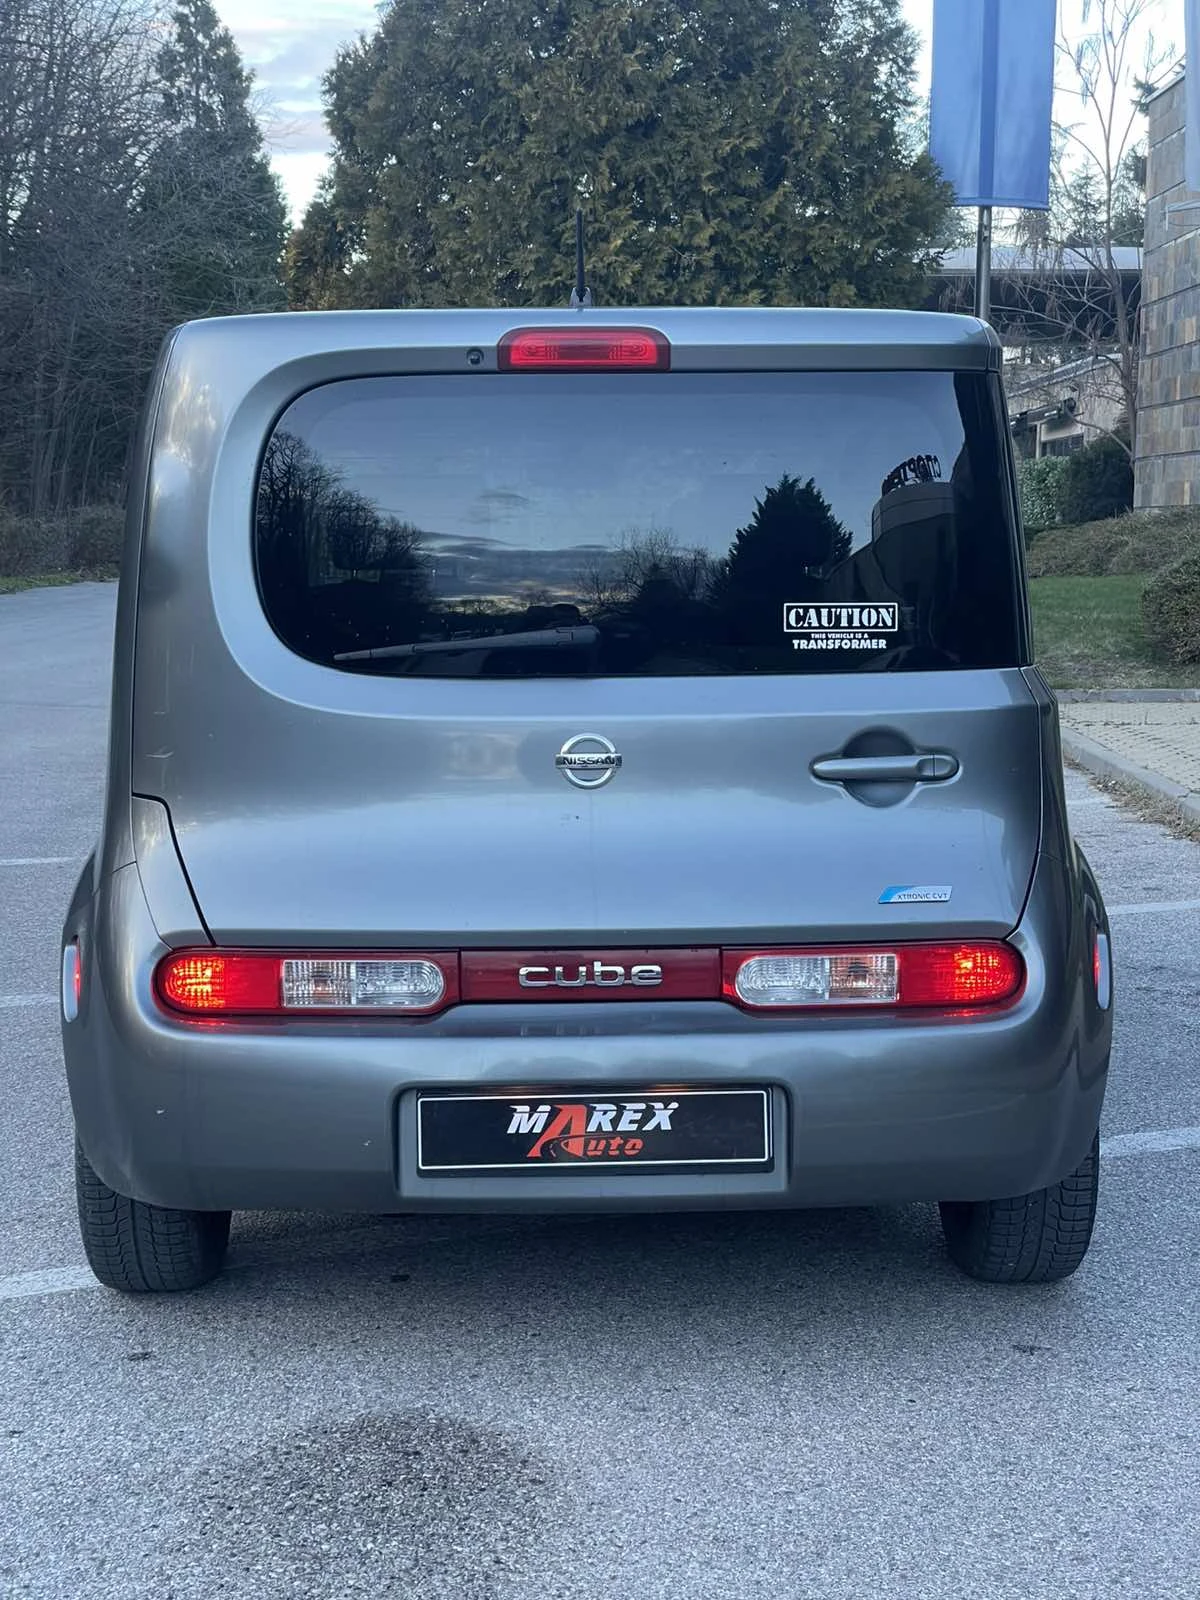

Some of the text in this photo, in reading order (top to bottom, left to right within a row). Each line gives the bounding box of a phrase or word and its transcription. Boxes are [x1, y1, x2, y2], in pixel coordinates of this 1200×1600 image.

[788, 608, 894, 627] CAUTION
[792, 639, 887, 649] TRANSFORMER
[562, 756, 615, 765] NISSAN
[518, 961, 663, 987] cube
[507, 1102, 679, 1157] MAREX
